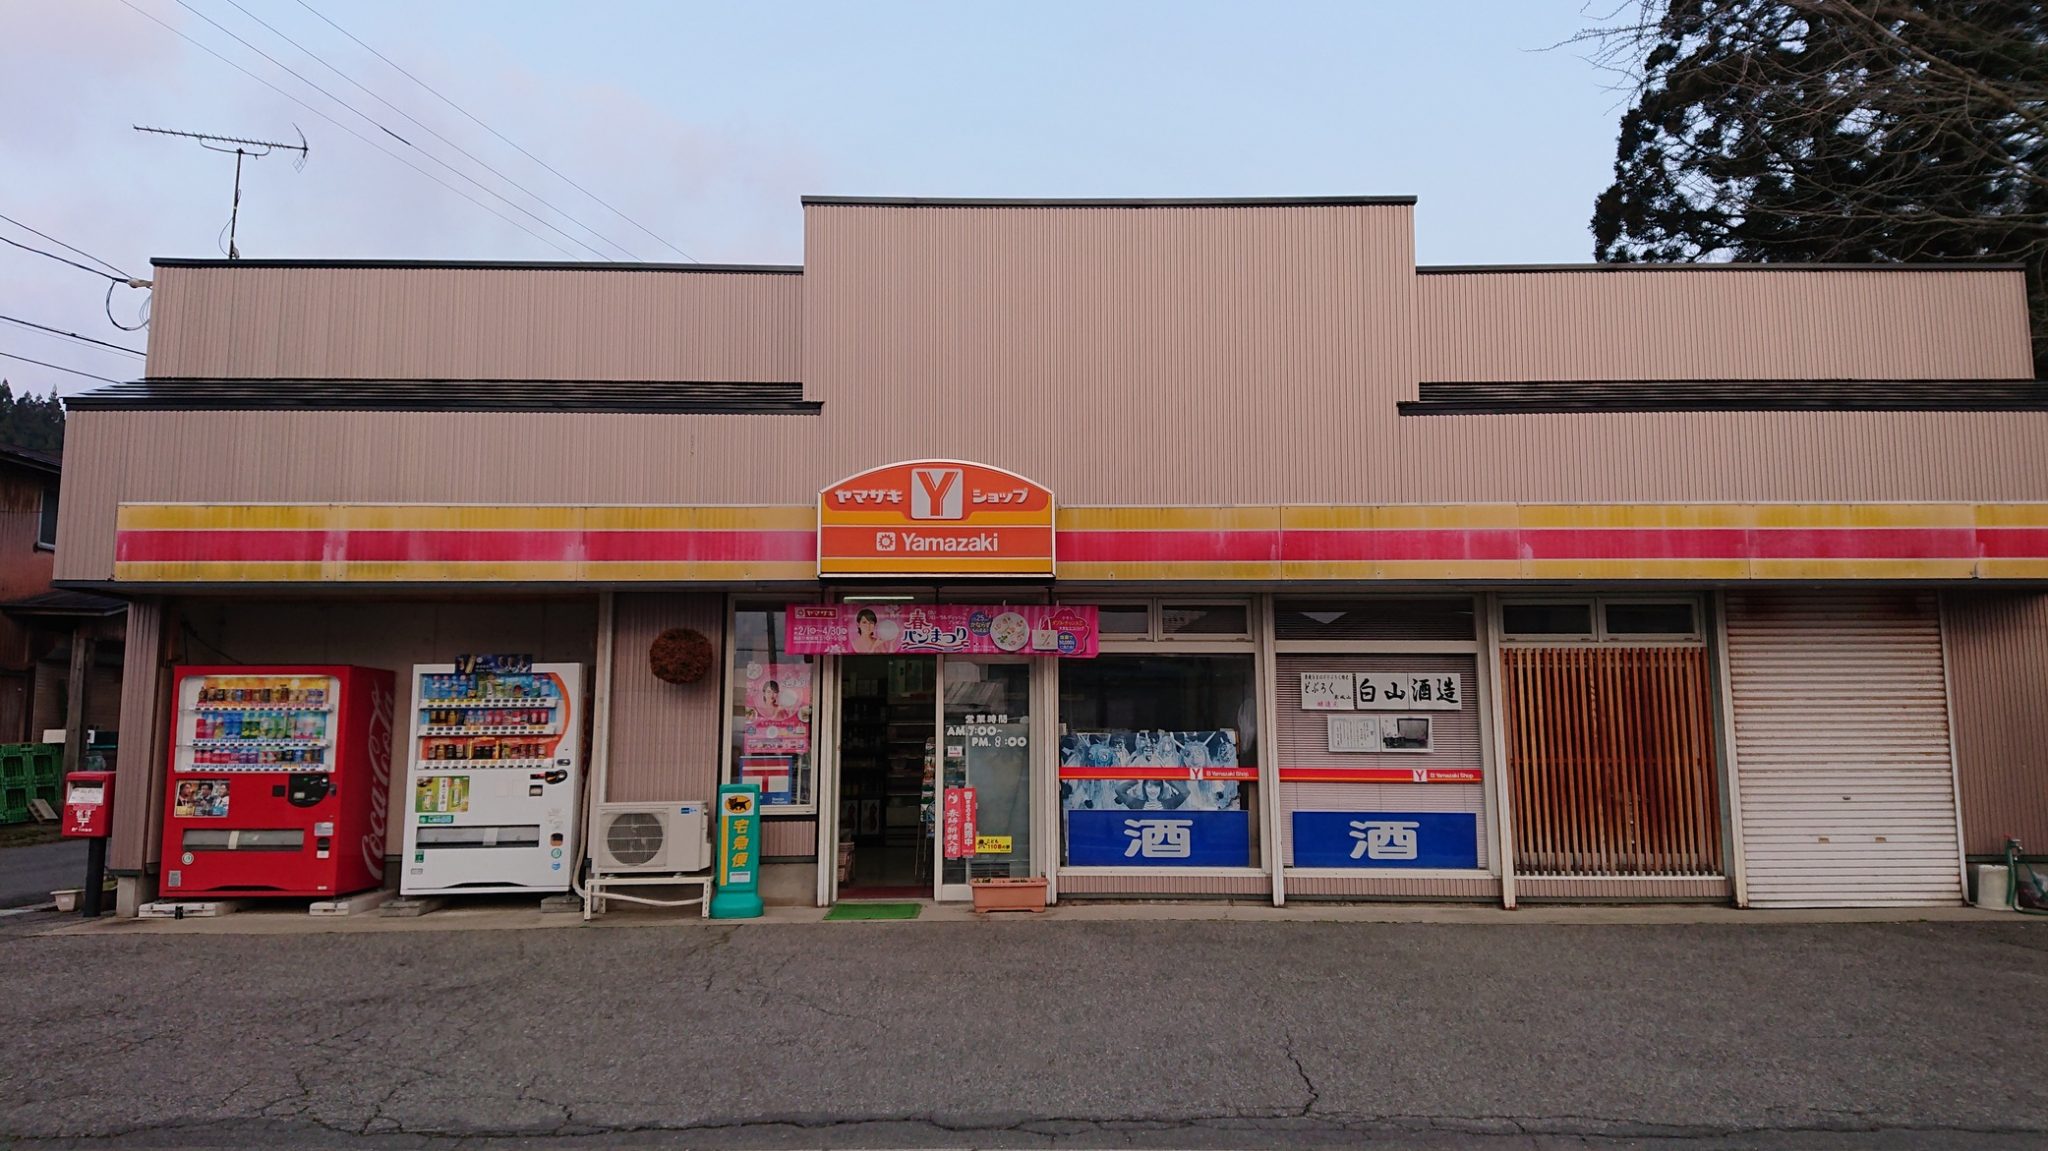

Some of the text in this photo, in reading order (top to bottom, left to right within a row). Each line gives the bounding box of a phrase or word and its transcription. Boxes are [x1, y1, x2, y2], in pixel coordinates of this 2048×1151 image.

[835, 471, 1029, 517] ヤマザキ Y ショップ
[902, 532, 998, 552] Yamazaki
[1304, 682, 1334, 695] どぶろく
[1359, 676, 1459, 704] 白山酒造
[731, 818, 750, 868] 宅急便
[1123, 818, 1194, 858] 酒
[1349, 820, 1420, 860] 酒
